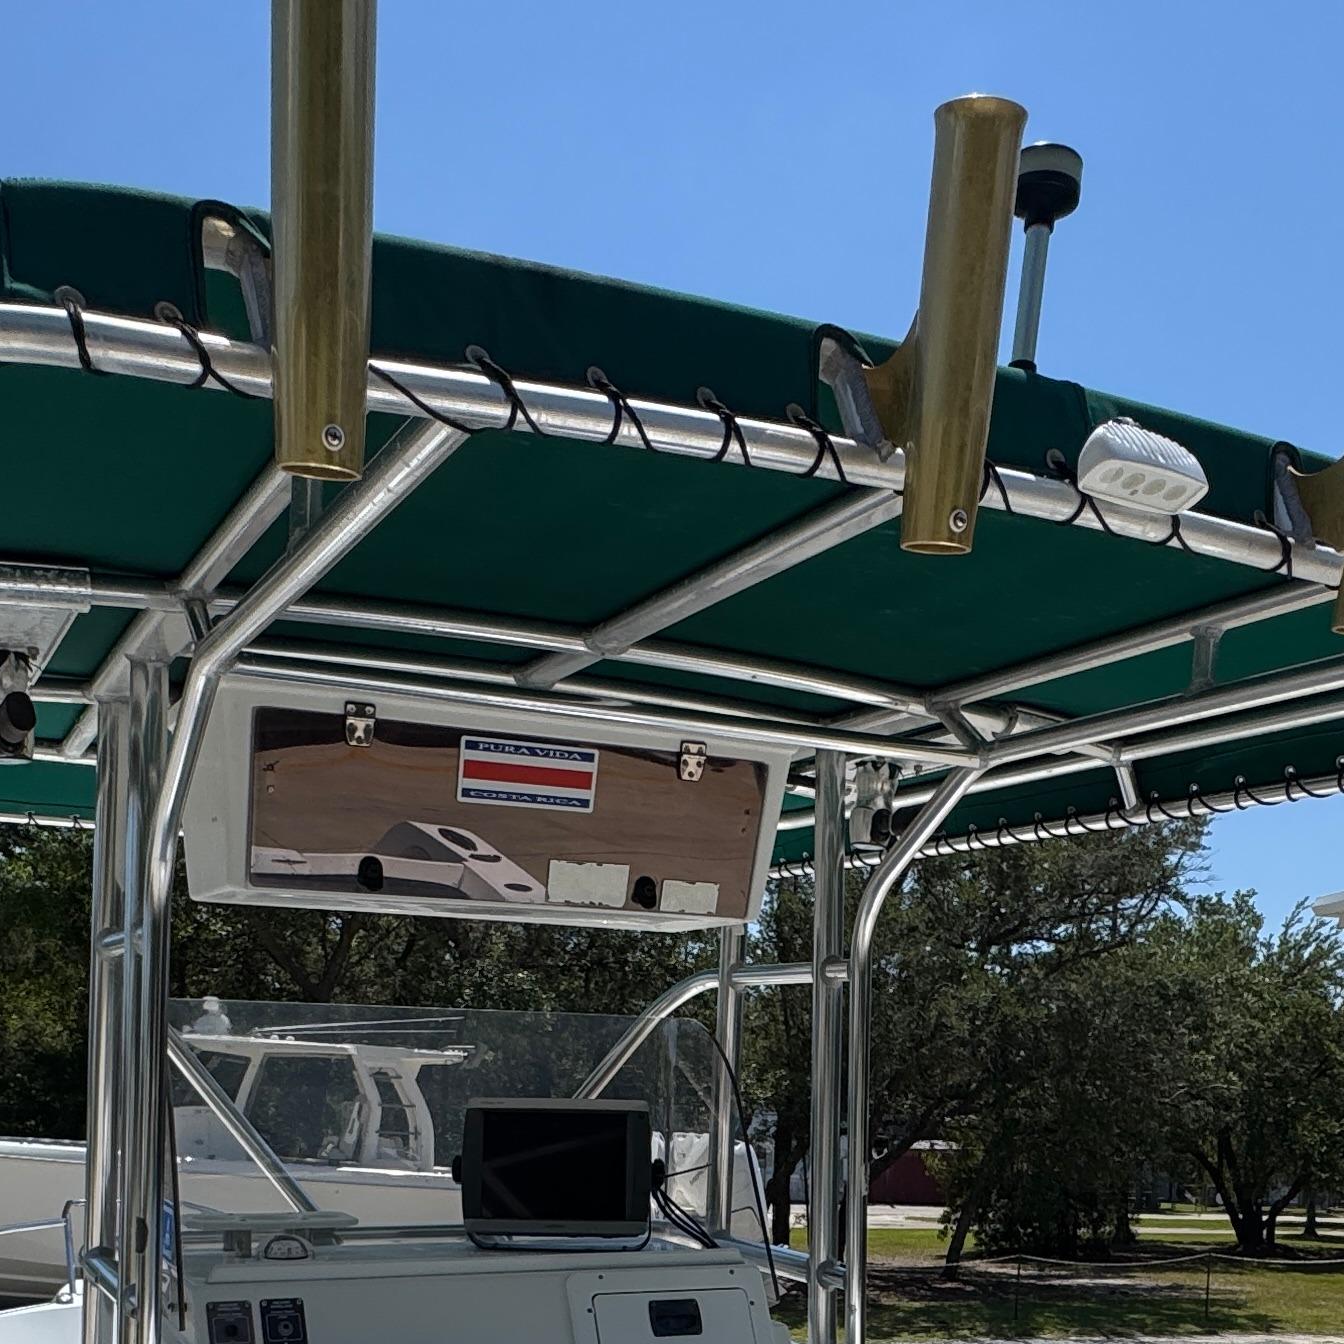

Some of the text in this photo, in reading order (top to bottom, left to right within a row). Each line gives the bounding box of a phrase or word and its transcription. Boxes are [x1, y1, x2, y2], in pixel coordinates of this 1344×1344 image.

[477, 742, 582, 761] PURA VIDA
[469, 790, 582, 807] COSTA RICA
